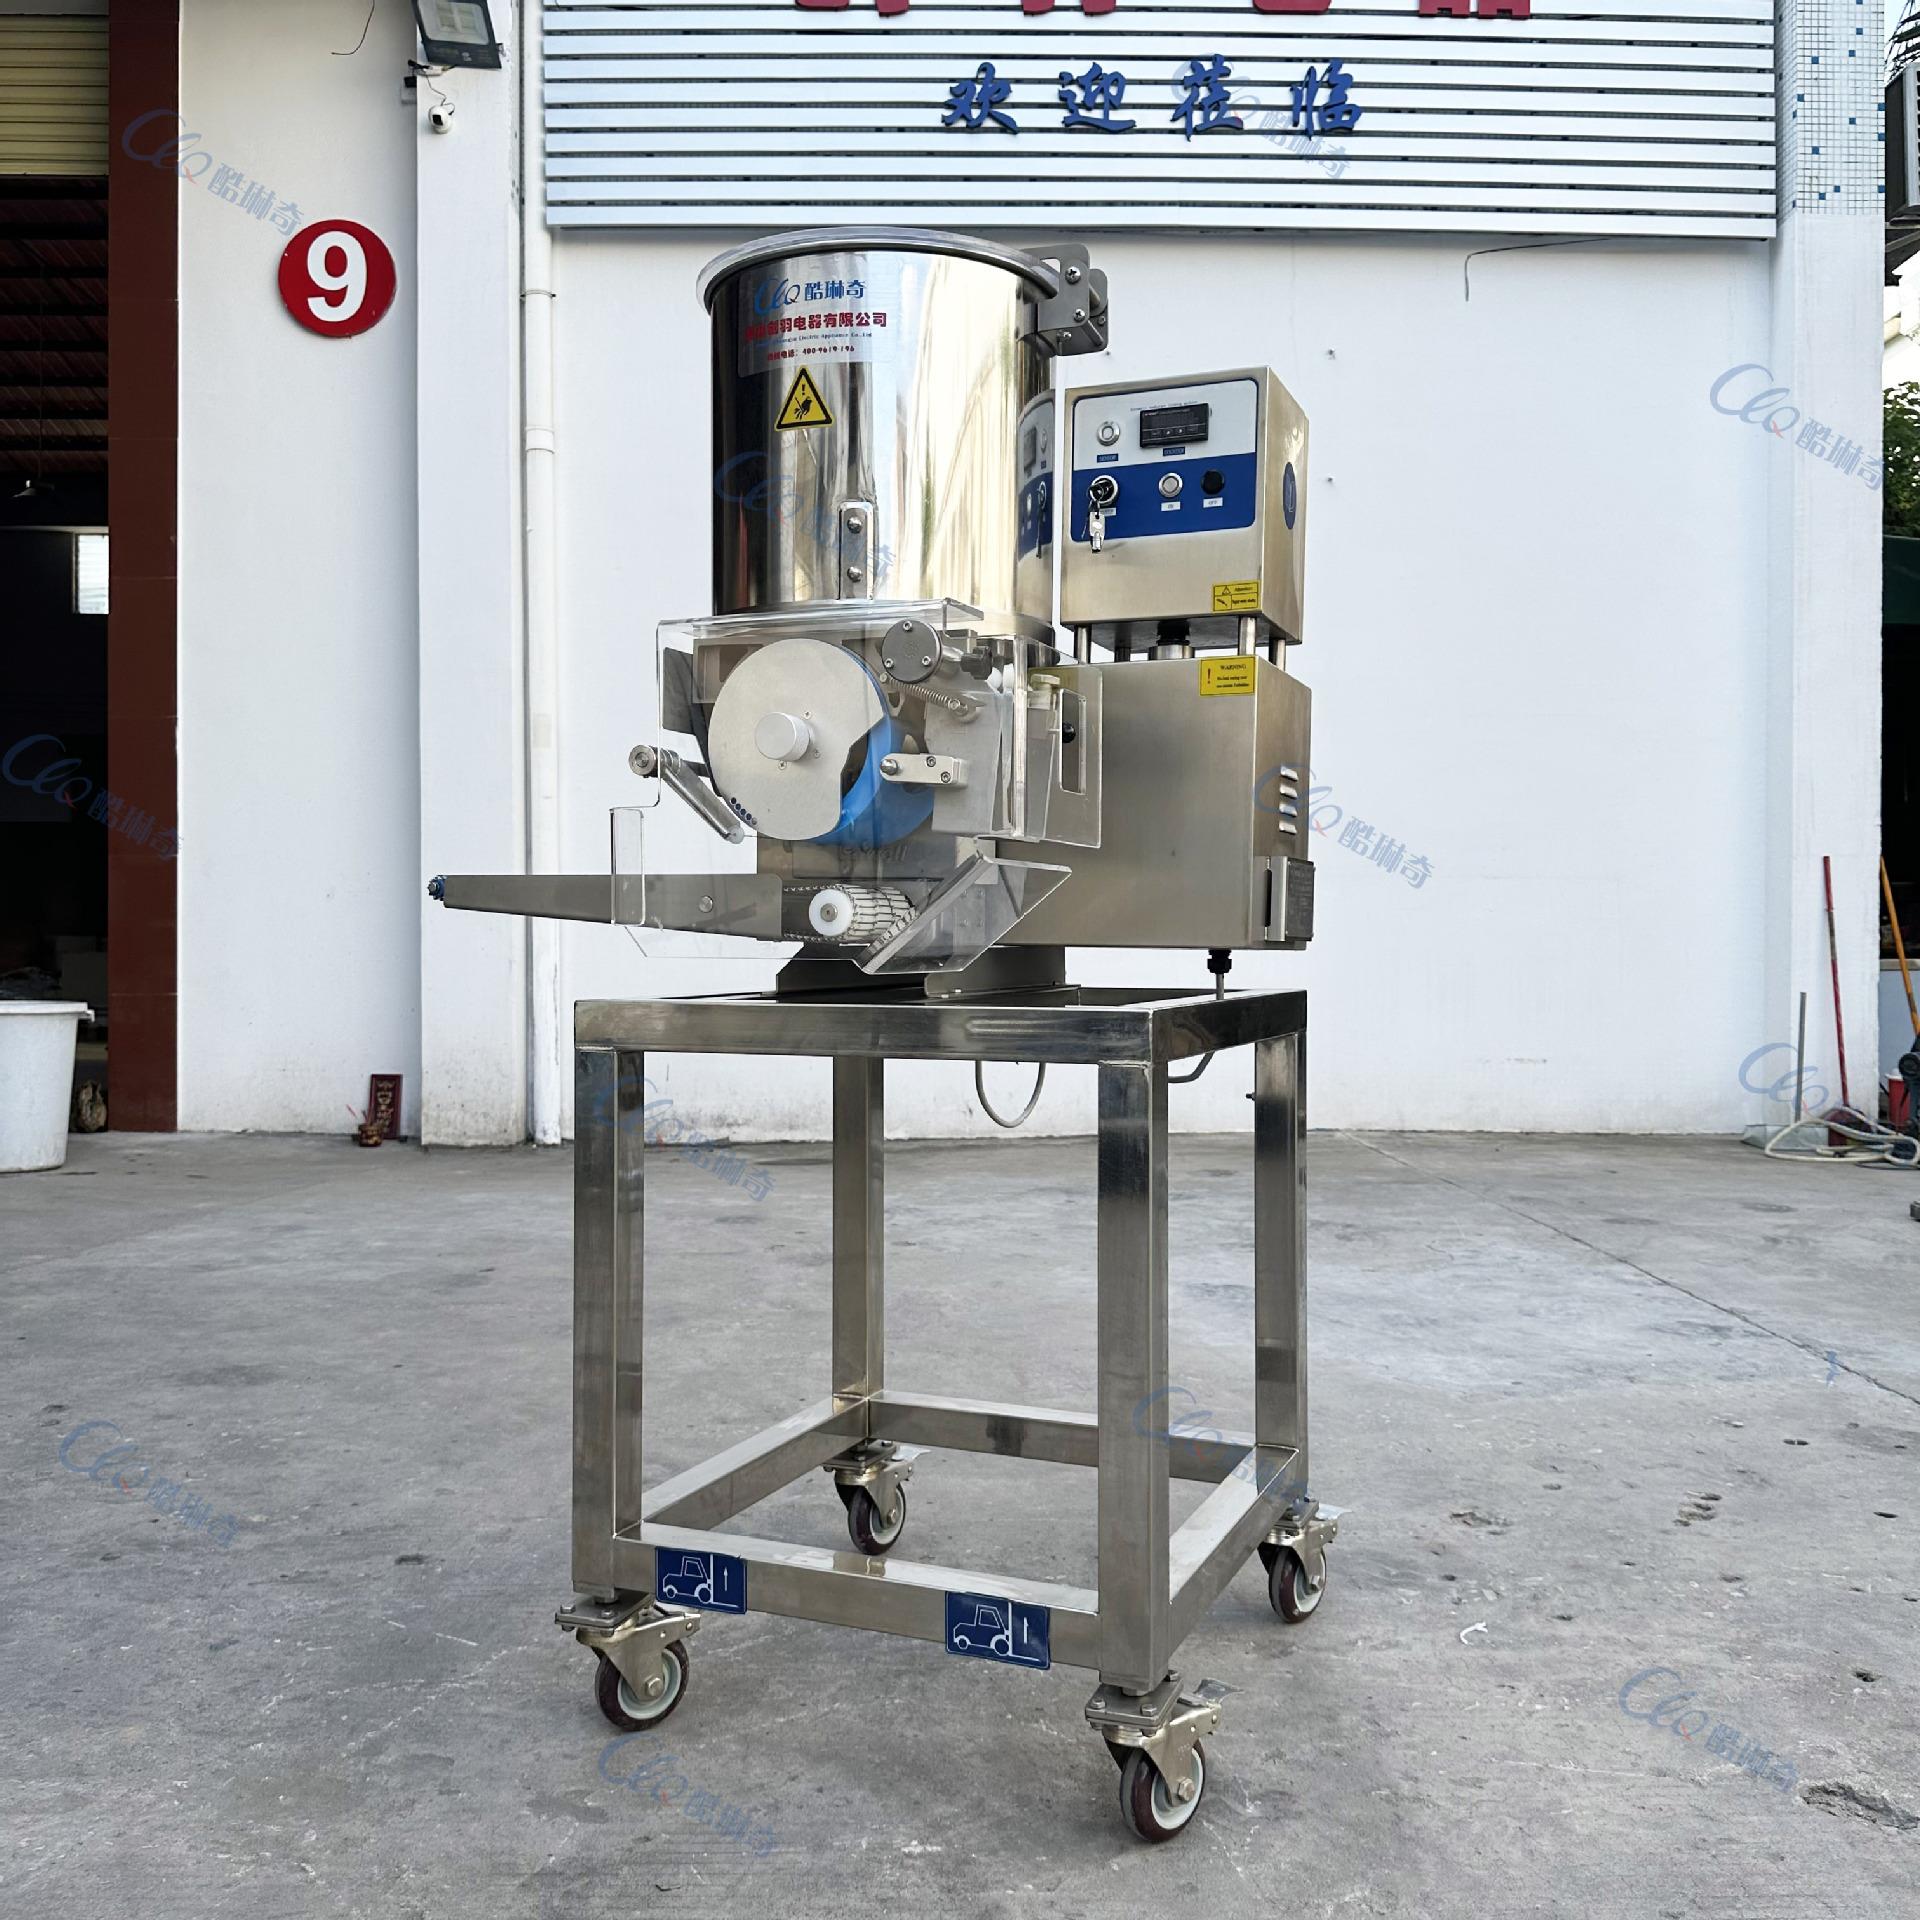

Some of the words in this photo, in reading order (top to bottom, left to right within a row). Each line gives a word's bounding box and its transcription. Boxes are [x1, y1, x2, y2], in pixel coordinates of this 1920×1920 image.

[941, 53, 1362, 142] 欢迎莅临
[307, 230, 367, 322] 9
[804, 279, 866, 302] 酷琳奇
